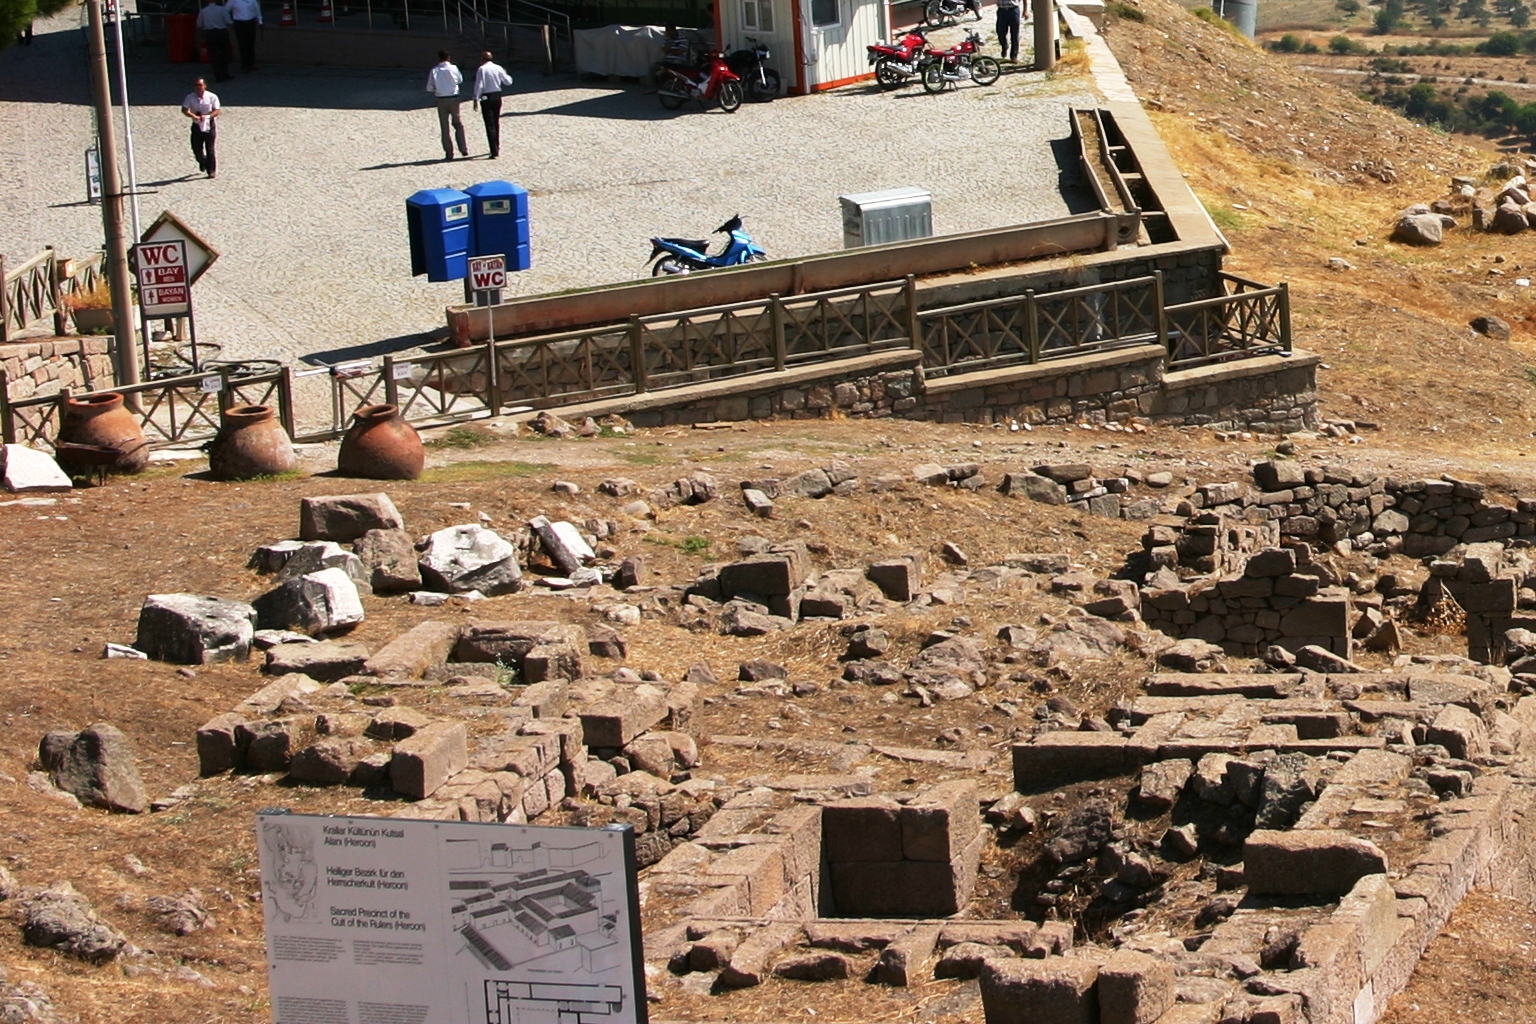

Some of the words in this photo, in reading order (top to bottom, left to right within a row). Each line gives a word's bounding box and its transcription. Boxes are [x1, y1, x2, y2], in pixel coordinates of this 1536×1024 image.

[140, 245, 179, 265] WC
[474, 271, 504, 287] WC
[159, 288, 184, 296] BAYAN
[390, 870, 404, 878] den
[330, 906, 357, 916] Sacred
[358, 908, 388, 918] Precinct
[389, 910, 397, 918] of
[398, 910, 410, 919] the
[331, 917, 346, 927] Cult
[347, 918, 354, 927] of
[356, 919, 368, 928] the
[370, 919, 393, 929] Rulers
